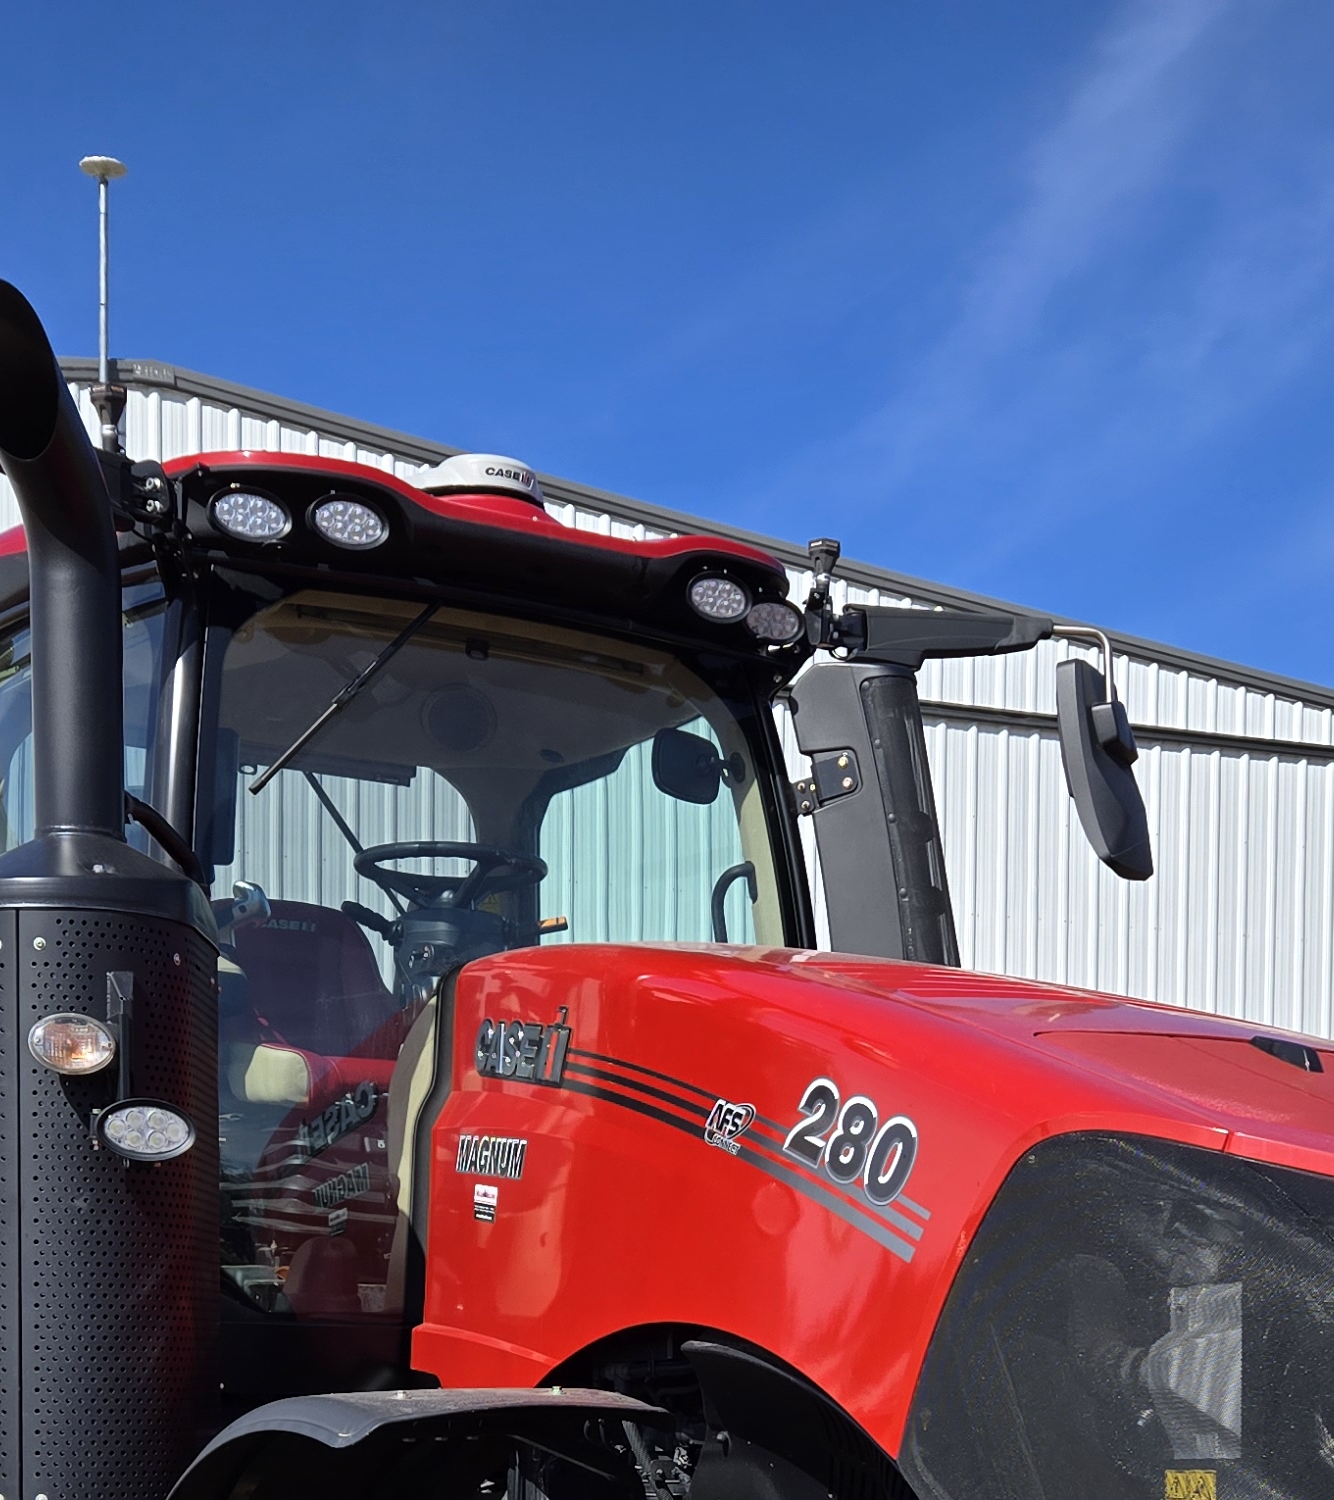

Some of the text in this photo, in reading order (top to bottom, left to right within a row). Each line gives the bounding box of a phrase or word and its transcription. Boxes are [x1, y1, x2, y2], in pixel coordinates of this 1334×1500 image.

[485, 467, 521, 482] CASE
[474, 1018, 543, 1080] CASE
[705, 1098, 746, 1136] AFS
[455, 1134, 528, 1180] MAGNUM
[783, 1076, 919, 1206] 280
